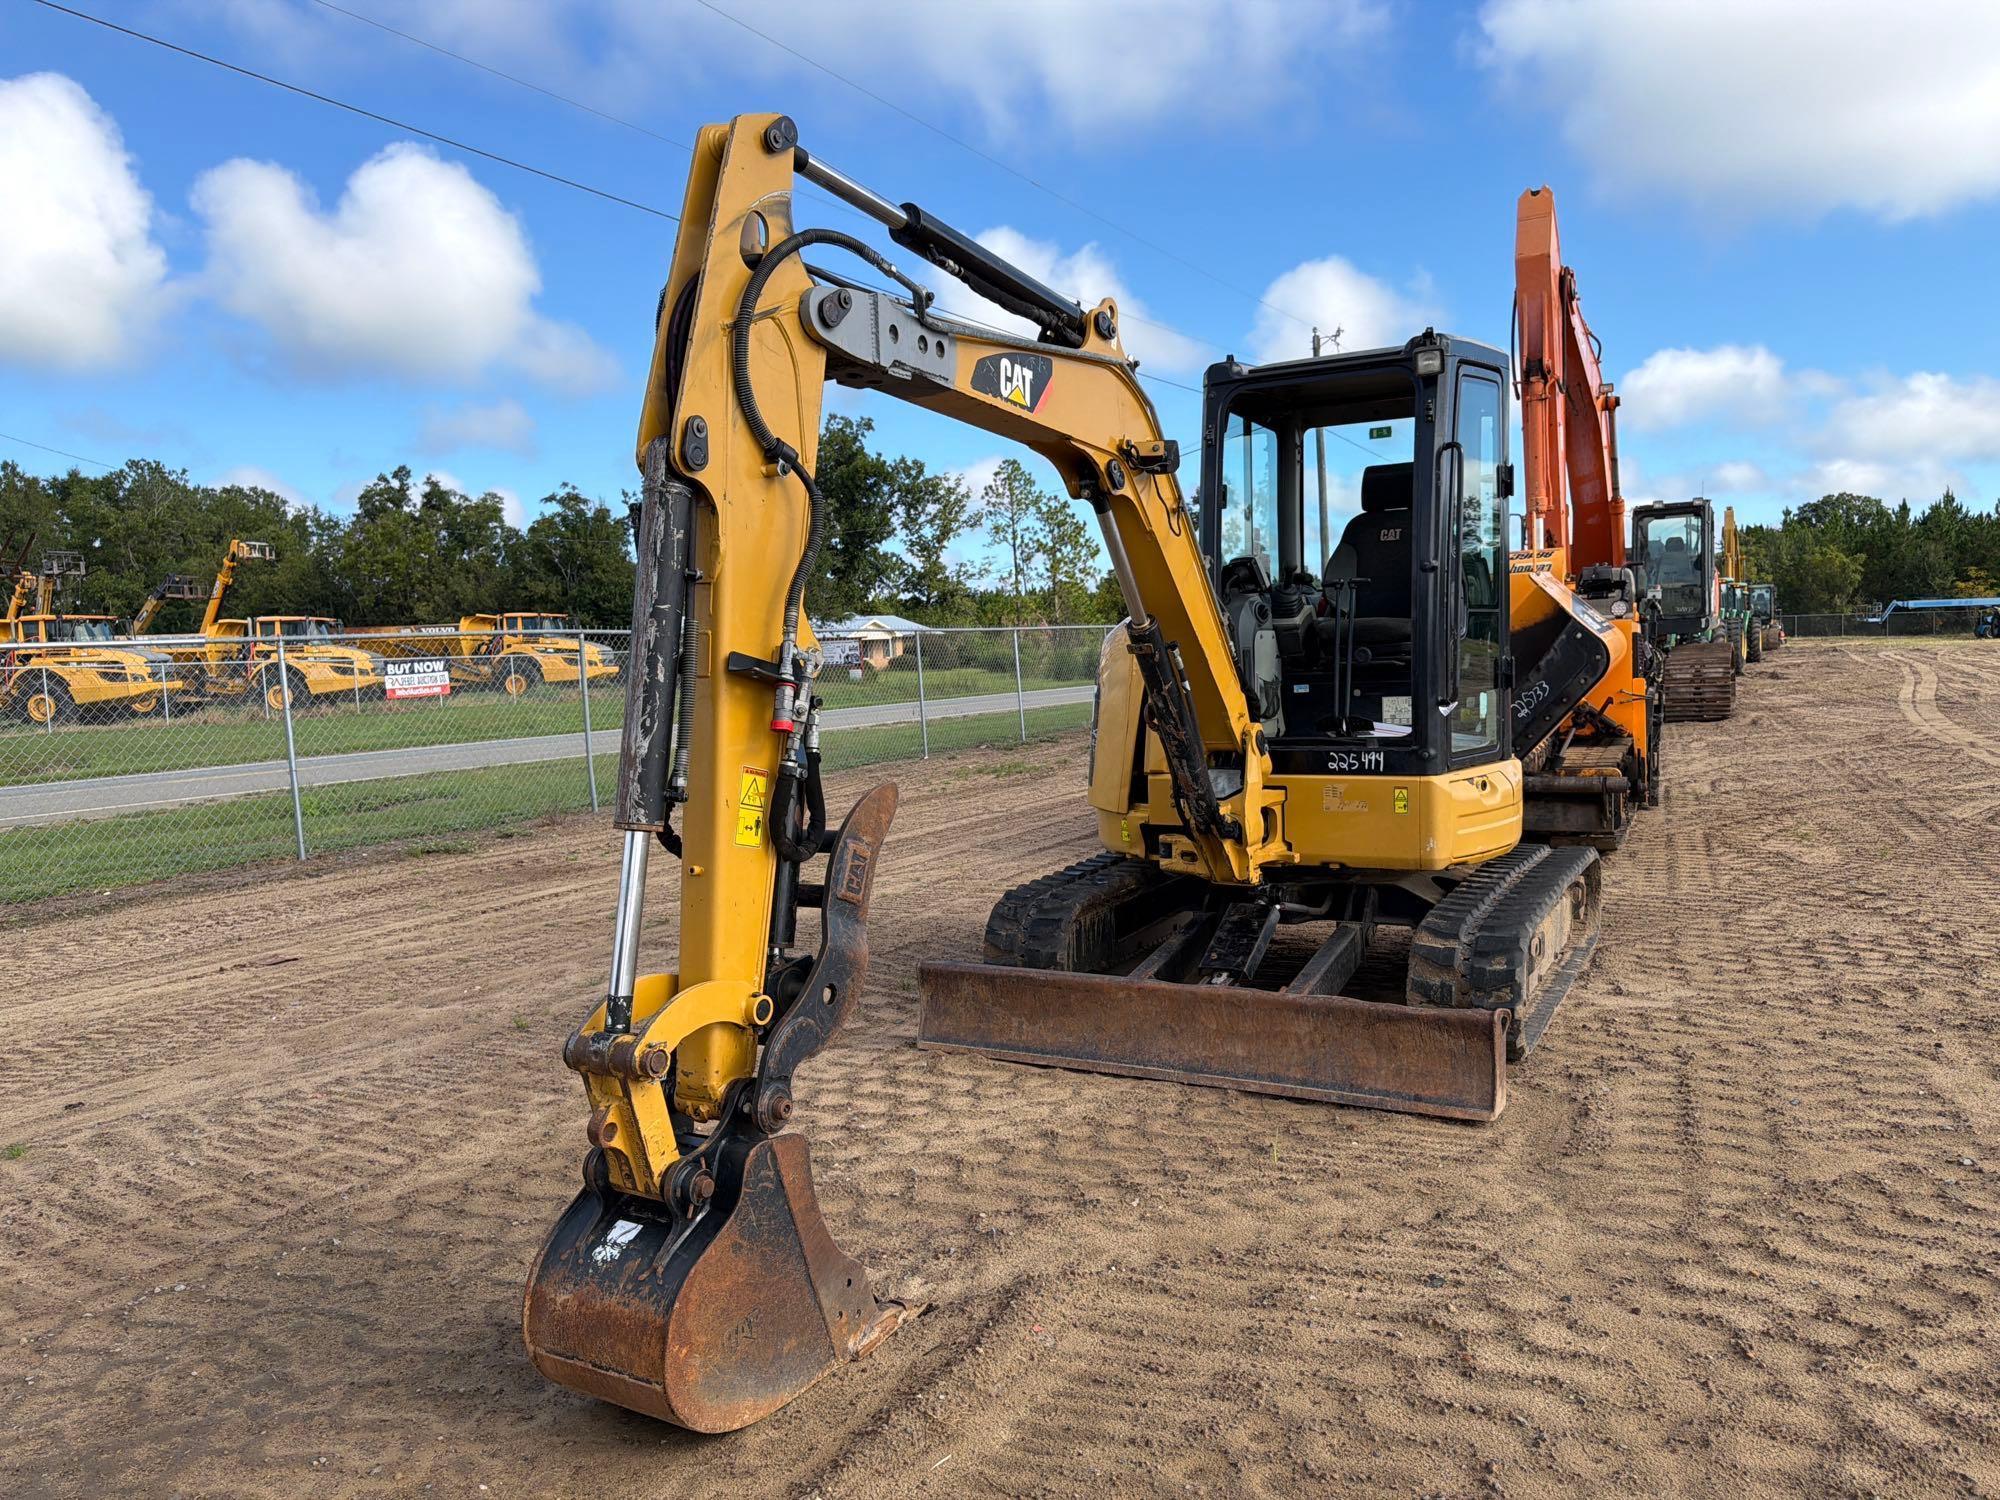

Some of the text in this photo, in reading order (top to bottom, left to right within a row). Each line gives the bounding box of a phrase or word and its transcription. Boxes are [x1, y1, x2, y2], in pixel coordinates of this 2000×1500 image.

[1000, 357, 1033, 407] CAT
[1380, 528, 1402, 541] CAT
[387, 661, 444, 674] BUY NOW
[1510, 681, 1550, 718] 225733
[1328, 751, 1384, 772] 225494
[846, 849, 868, 895] CAT
